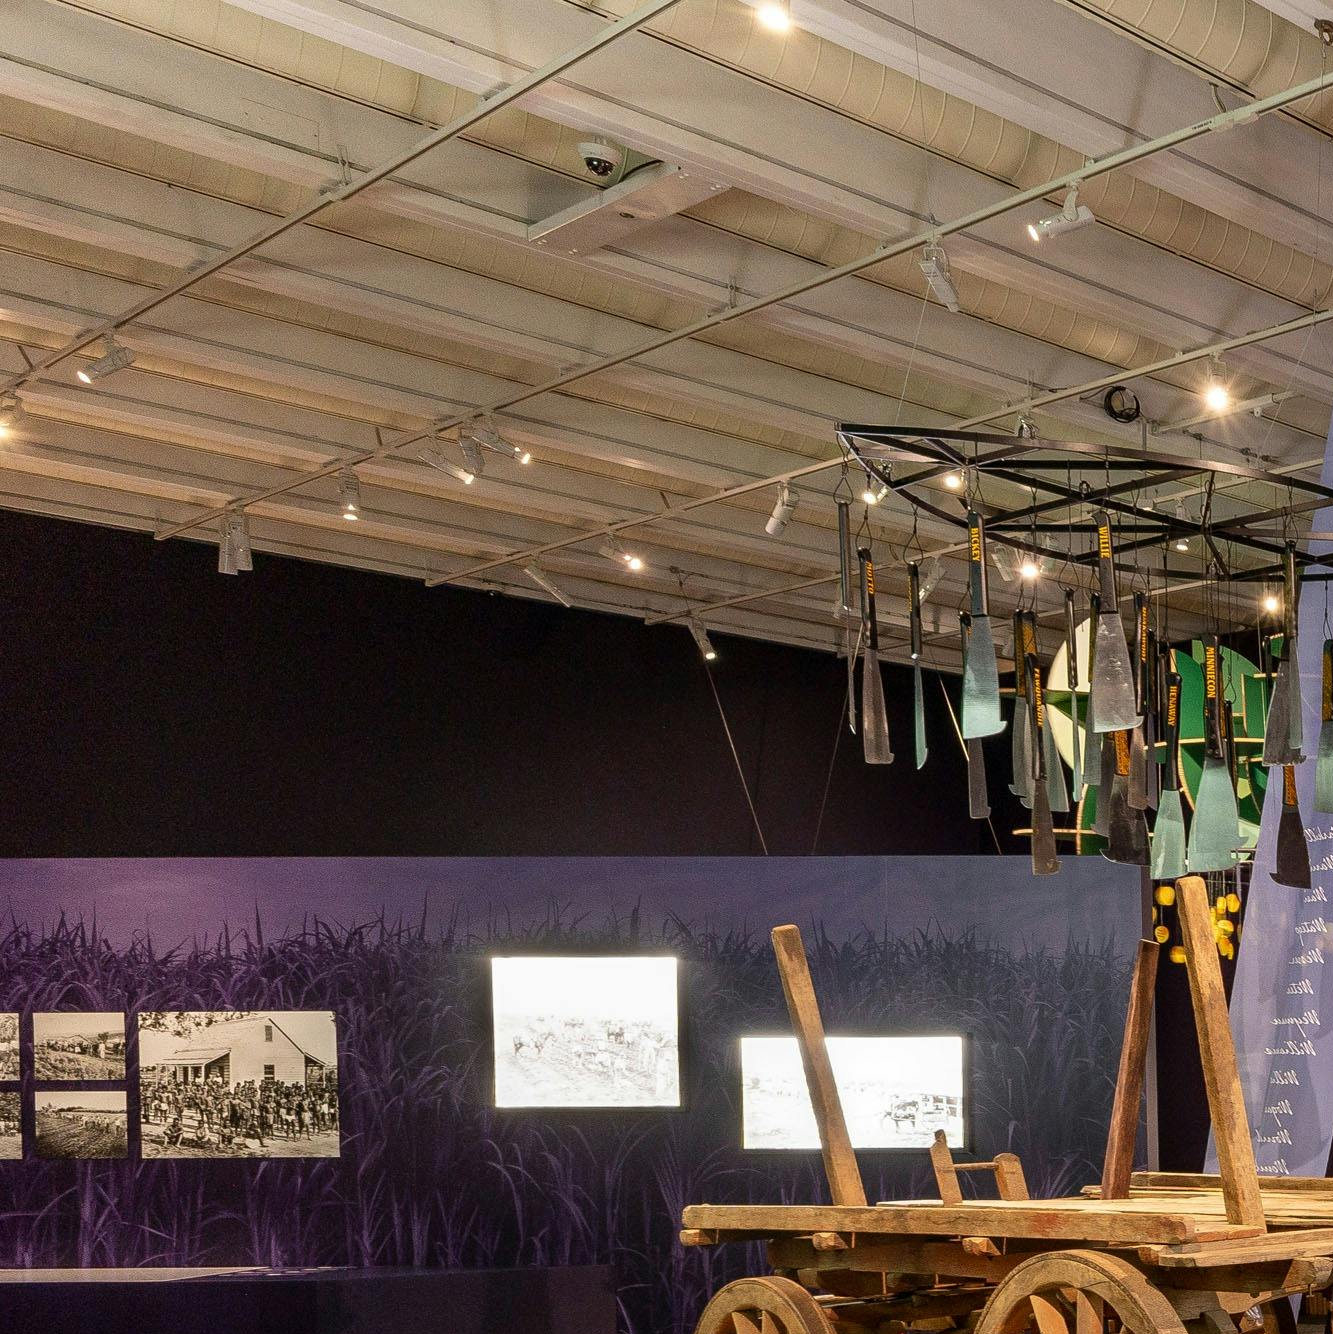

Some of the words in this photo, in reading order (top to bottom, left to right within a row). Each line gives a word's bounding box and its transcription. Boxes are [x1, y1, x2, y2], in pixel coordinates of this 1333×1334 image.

[971, 527, 980, 561] BICKEY
[1098, 526, 1110, 559] WILLIE
[1206, 646, 1216, 698] MINNIECON
[1168, 686, 1178, 727] HENAWAY
